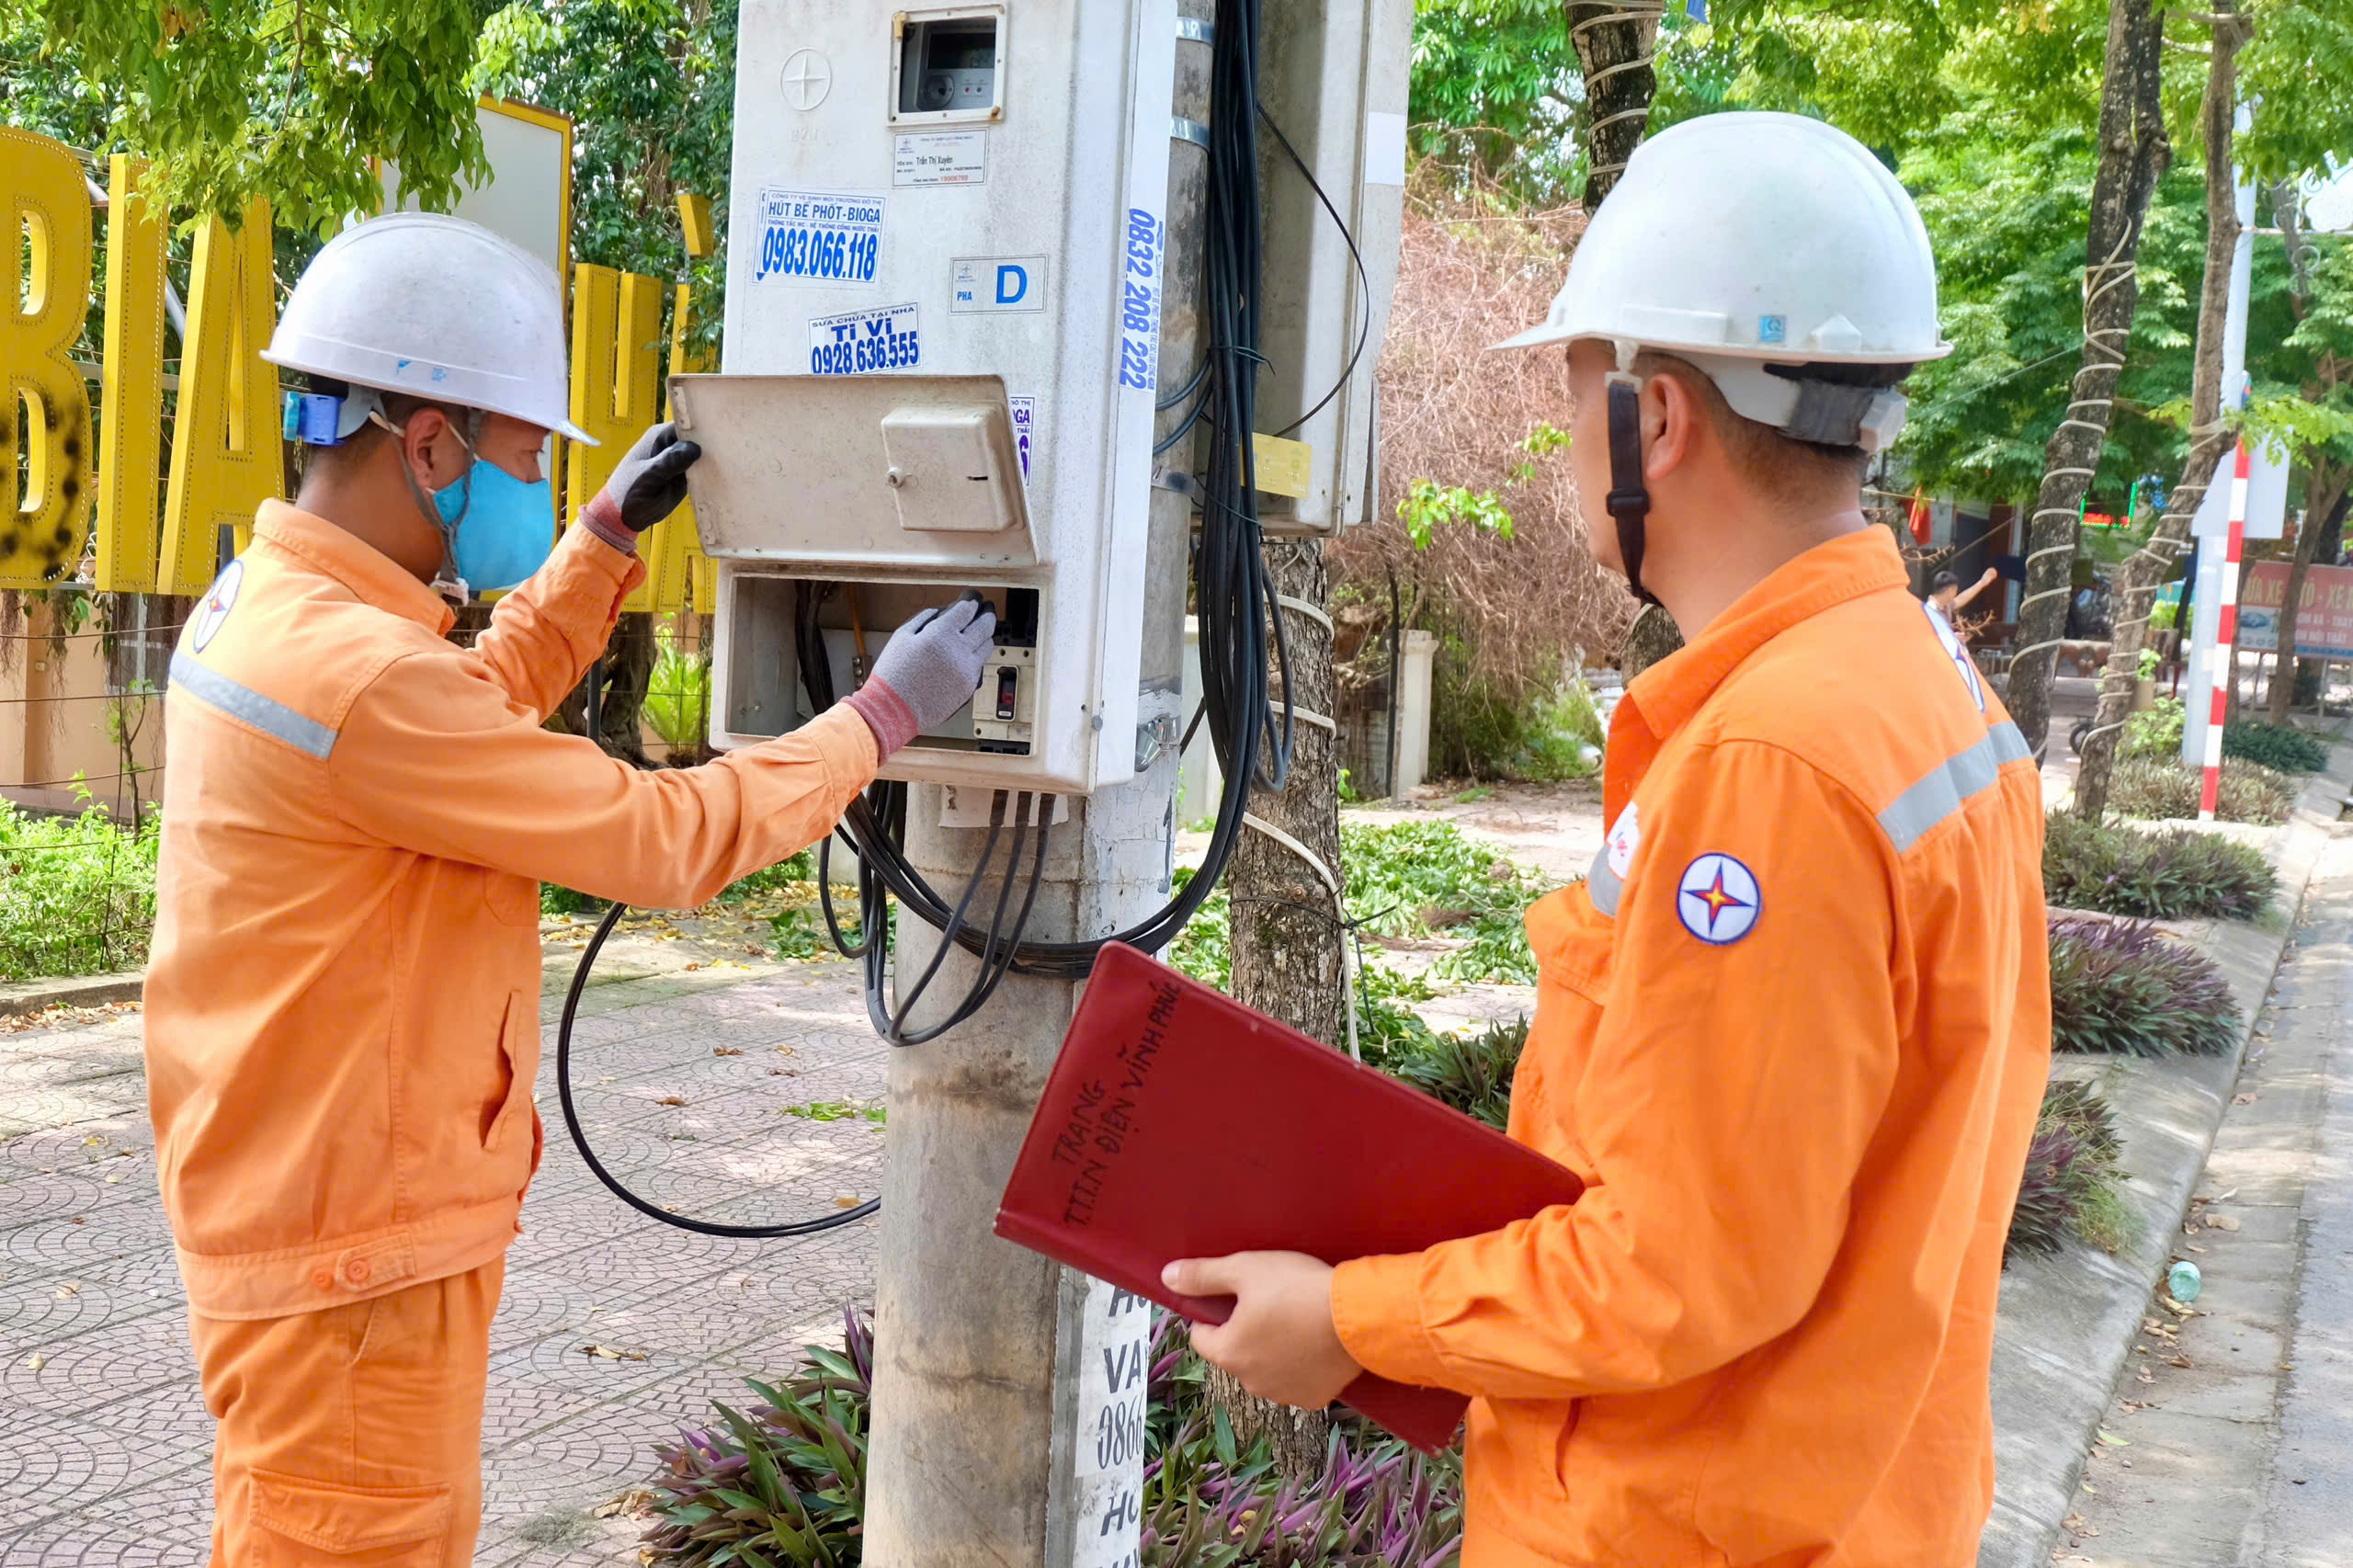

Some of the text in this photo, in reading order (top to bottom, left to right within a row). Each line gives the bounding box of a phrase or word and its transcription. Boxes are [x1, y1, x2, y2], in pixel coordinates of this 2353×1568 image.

[768, 199, 791, 217] HÚT
[763, 226, 878, 280] 0983.066.118
[957, 265, 1029, 303] PHA D
[0, 125, 286, 595] BIA
[812, 331, 919, 374] 0928.636.555
[1013, 408, 1030, 424] GA
[1148, 979, 1182, 1028] PHÚC
[1051, 1080, 1107, 1165] TRANG
[1103, 1335, 1149, 1394] VA
